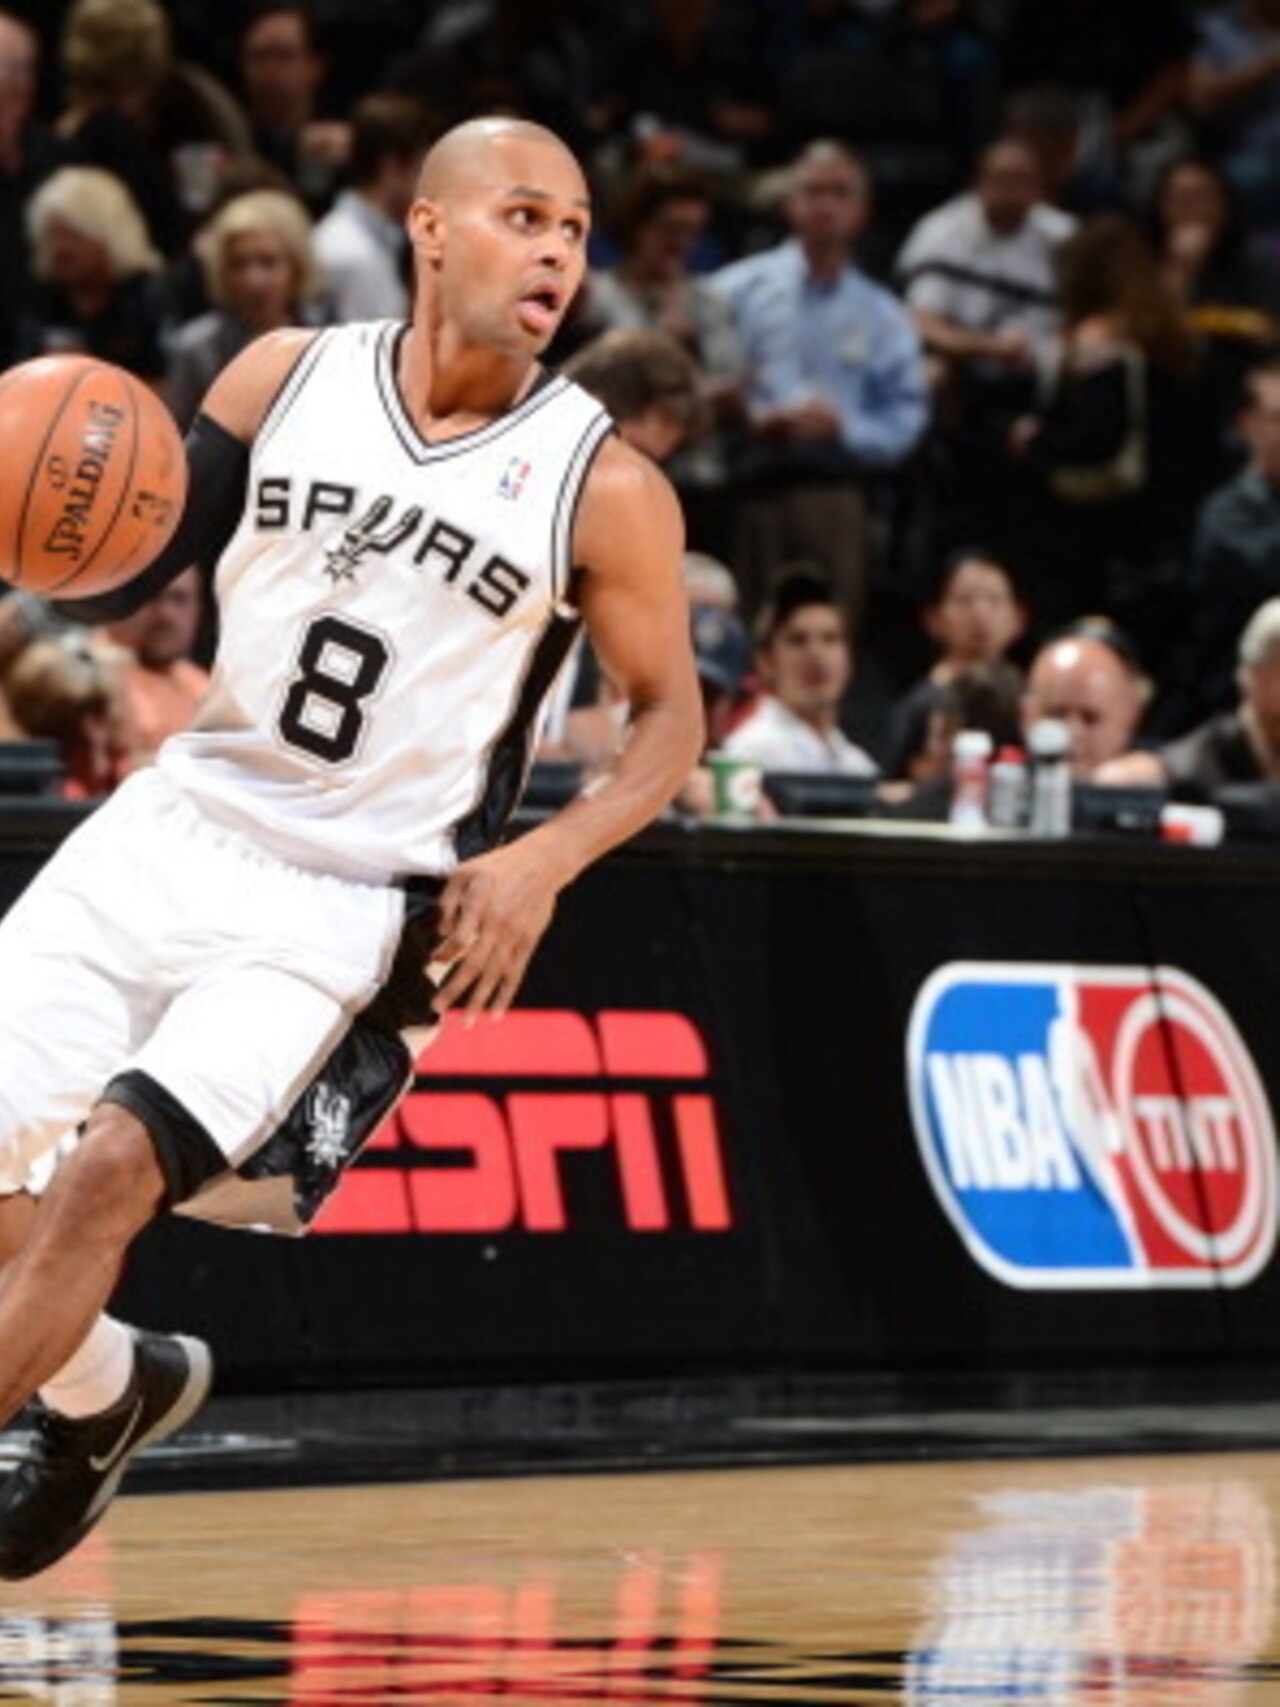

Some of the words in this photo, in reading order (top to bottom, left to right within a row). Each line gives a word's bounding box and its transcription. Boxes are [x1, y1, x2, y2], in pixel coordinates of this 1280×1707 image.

[255, 477, 531, 619] SPURS
[275, 611, 393, 768] 8
[926, 1052, 1082, 1190] NBA
[1133, 1095, 1238, 1172] TNT
